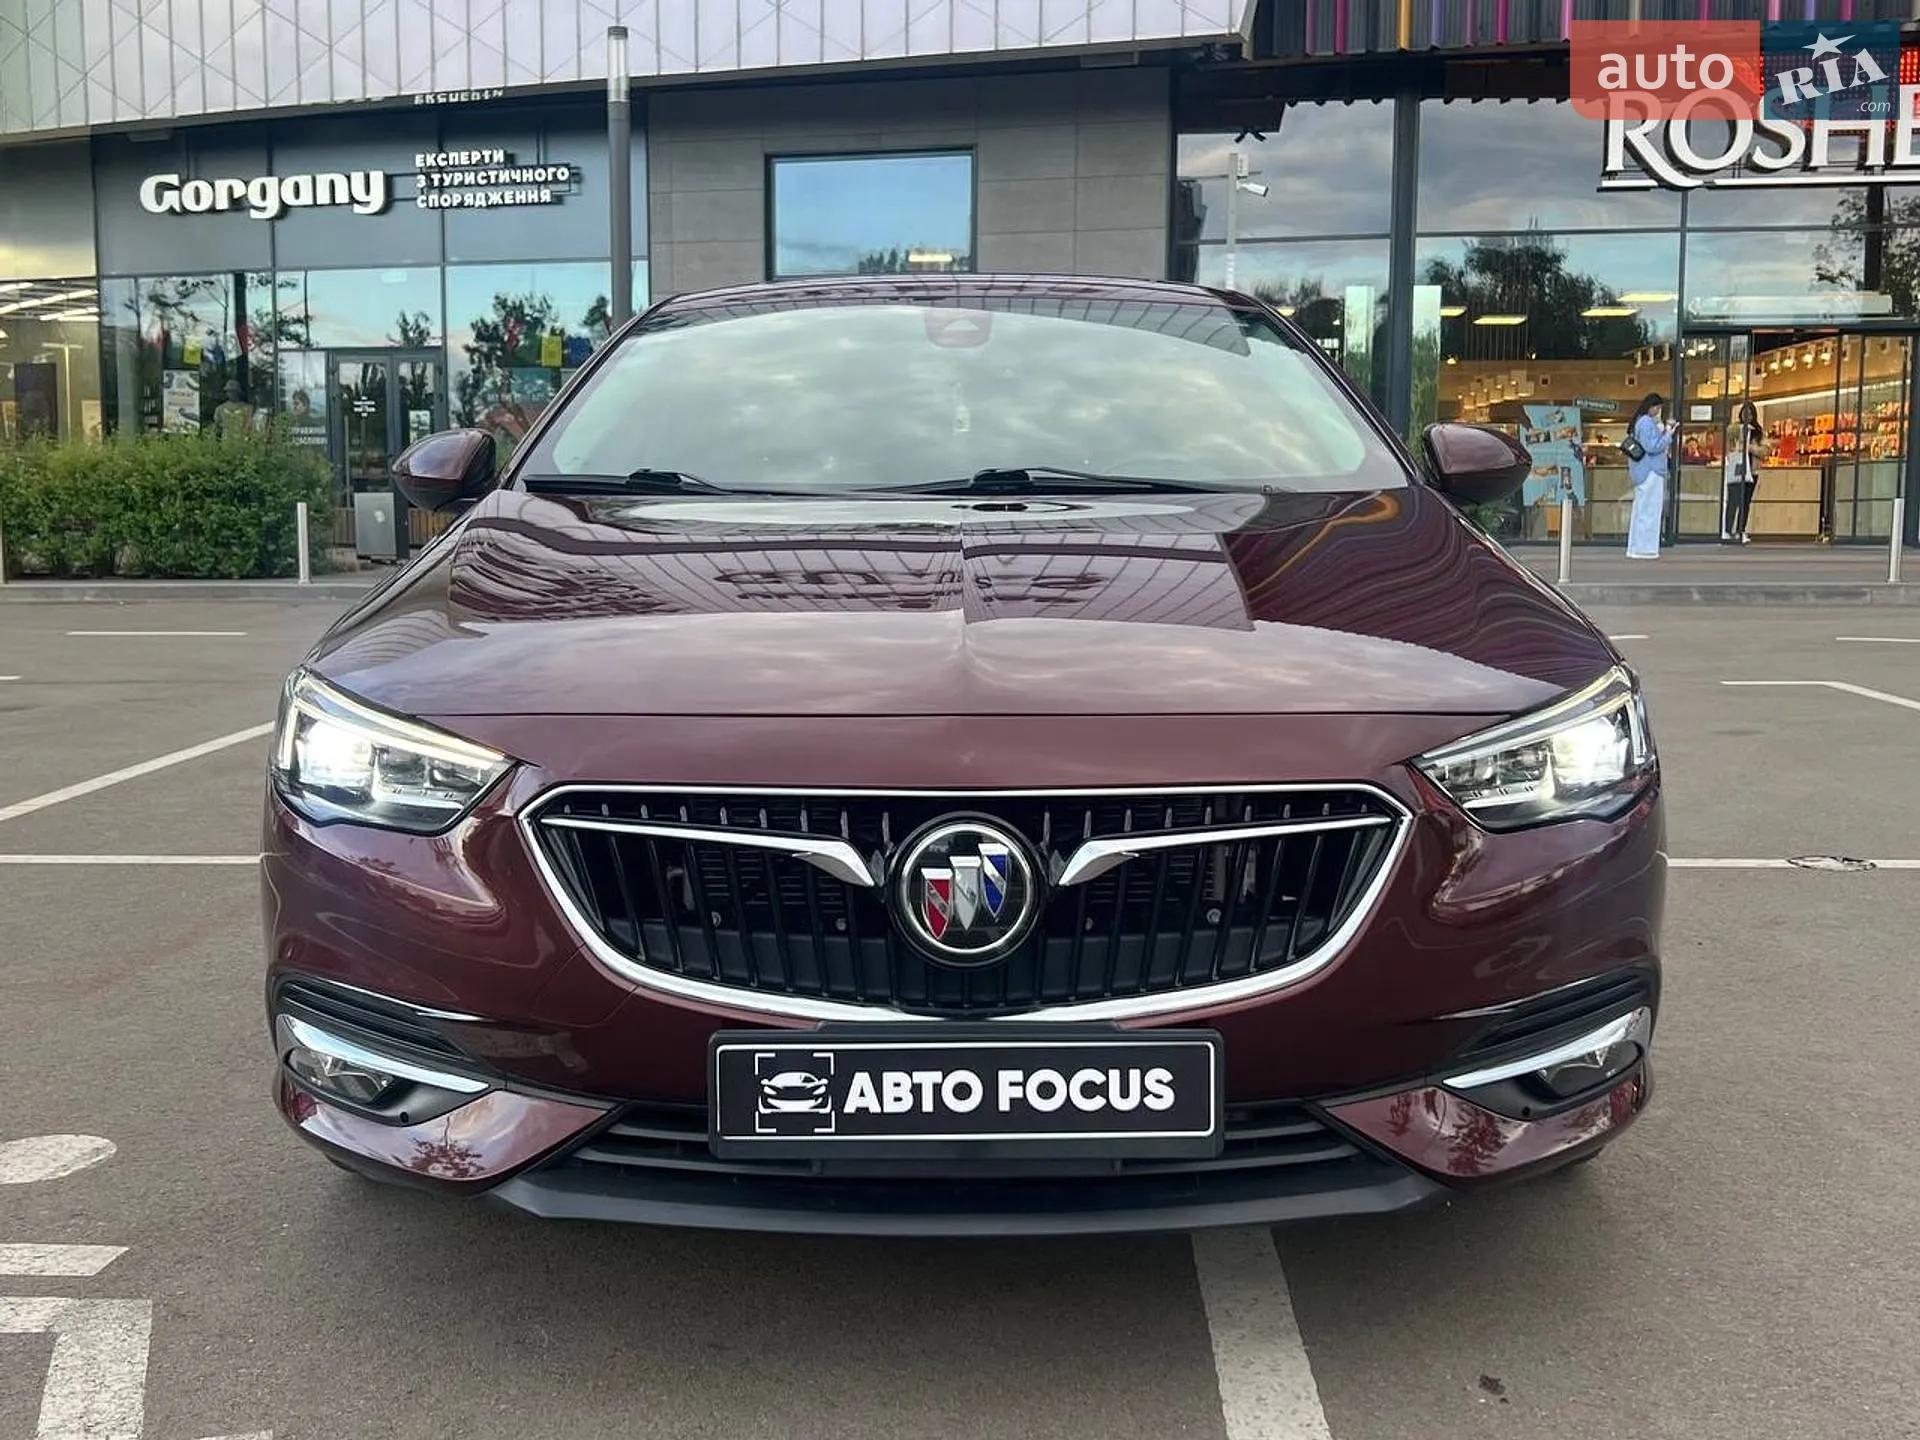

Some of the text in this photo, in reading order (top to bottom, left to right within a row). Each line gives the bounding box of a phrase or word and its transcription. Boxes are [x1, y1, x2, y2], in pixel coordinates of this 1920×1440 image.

[415, 149, 505, 168] ЕКСПЕРТИ
[431, 166, 570, 187] ТУРИСТИЧНОГО
[139, 169, 385, 220] Gorgany
[415, 188, 552, 209] СПОРЯДЖЕННЯ
[844, 1069, 1175, 1114] АВТО FOCUS
